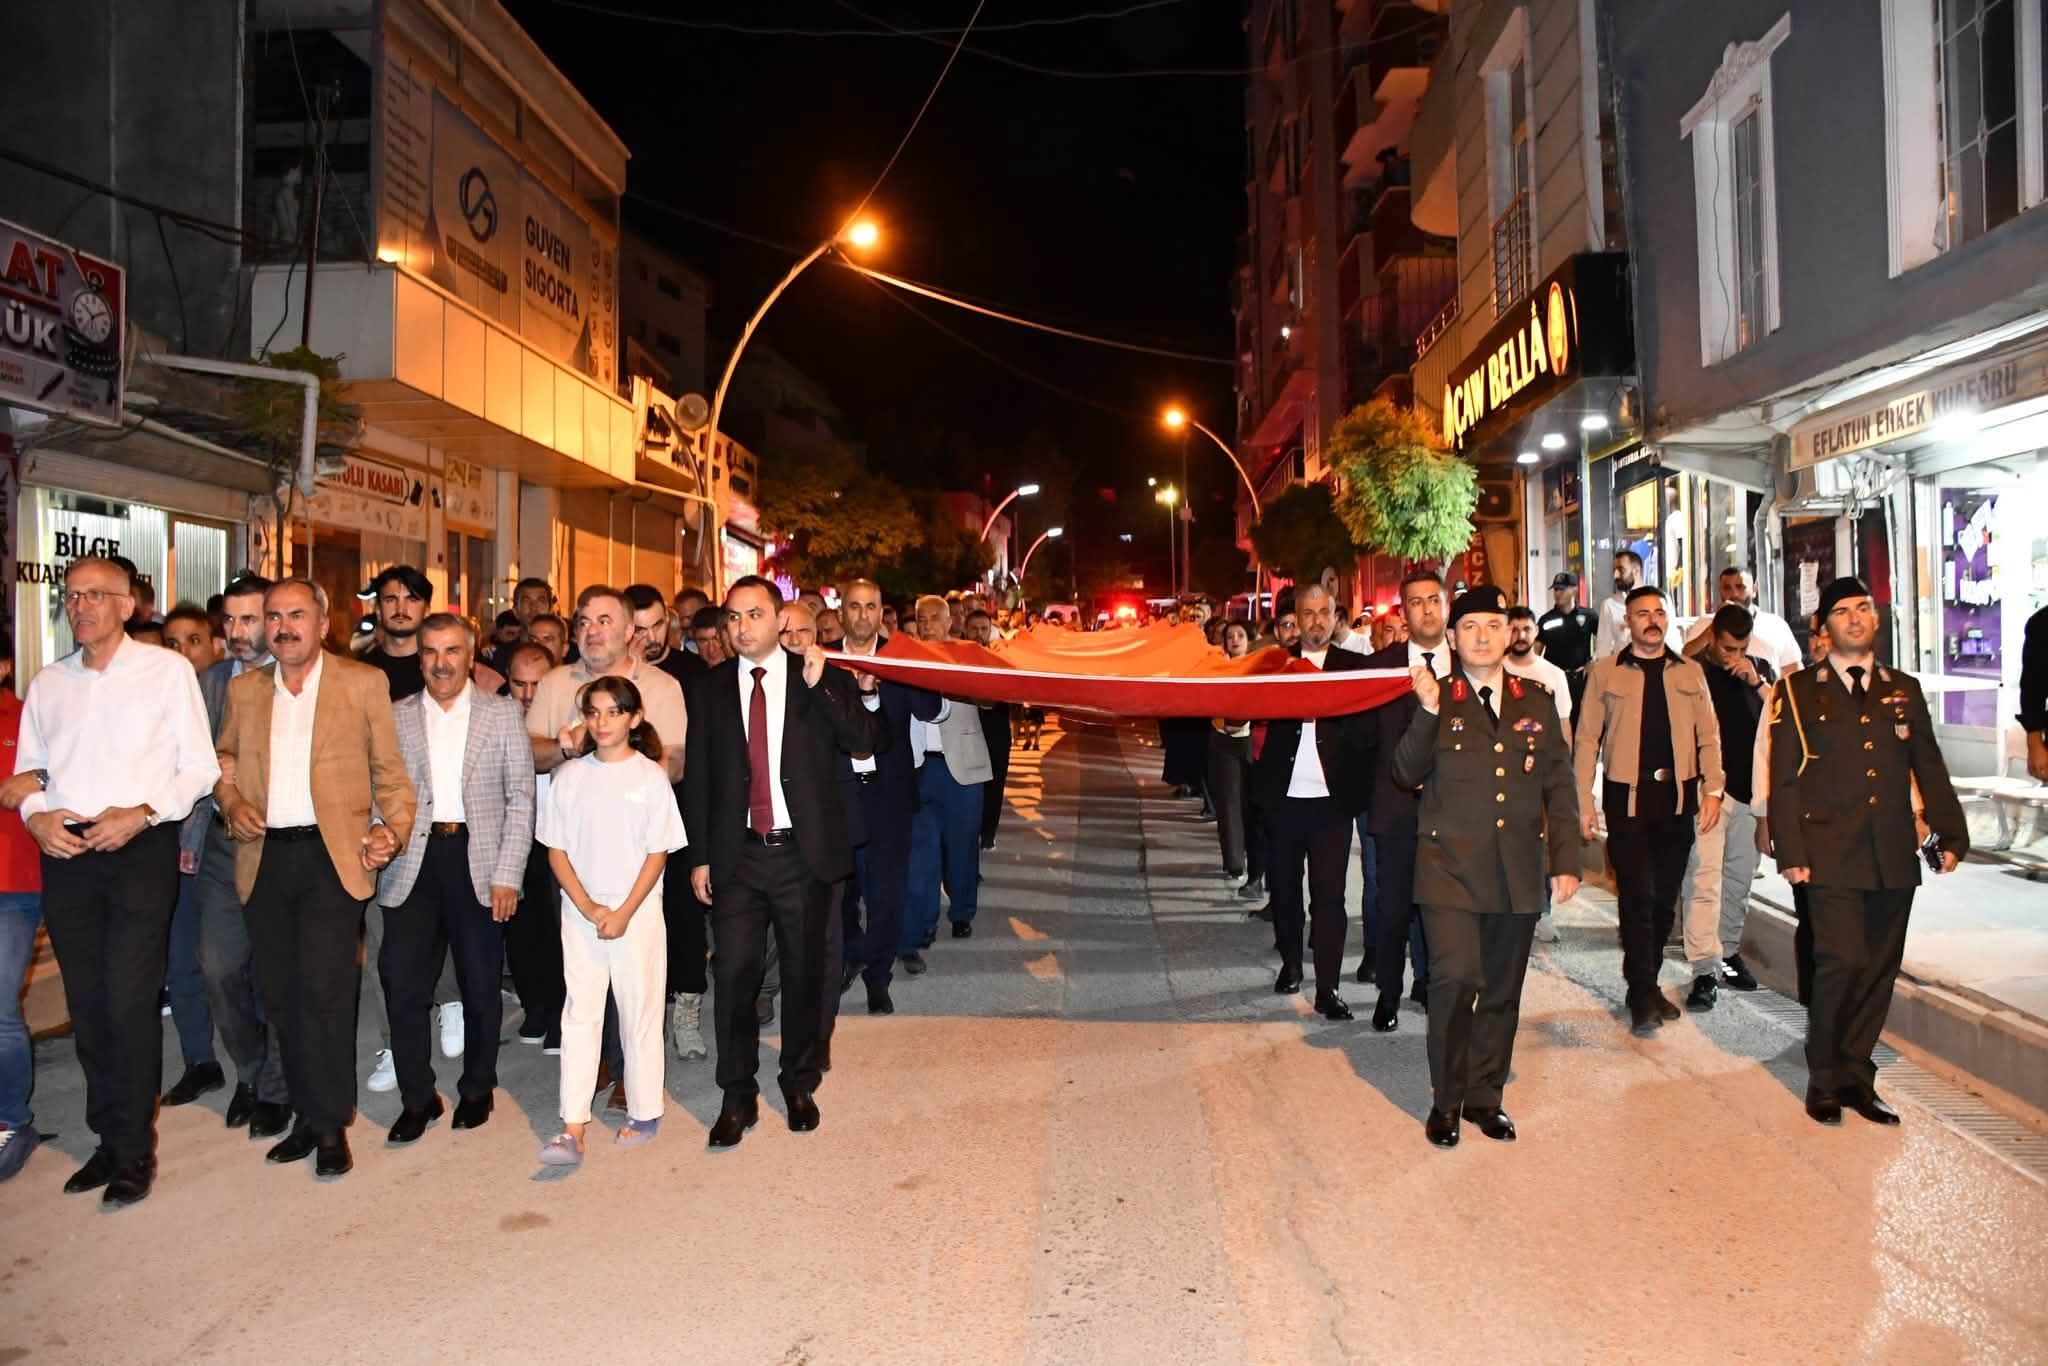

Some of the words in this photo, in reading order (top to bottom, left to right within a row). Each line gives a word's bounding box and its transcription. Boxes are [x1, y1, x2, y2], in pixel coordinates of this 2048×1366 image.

[3, 240, 64, 297] AT
[0, 299, 56, 352] ÜK
[1813, 417, 1871, 457] EFLATUN
[1876, 394, 1926, 437] ERKEK
[337, 463, 364, 488] OLU
[54, 526, 120, 558] BİLGE
[16, 559, 74, 584] KUAF
